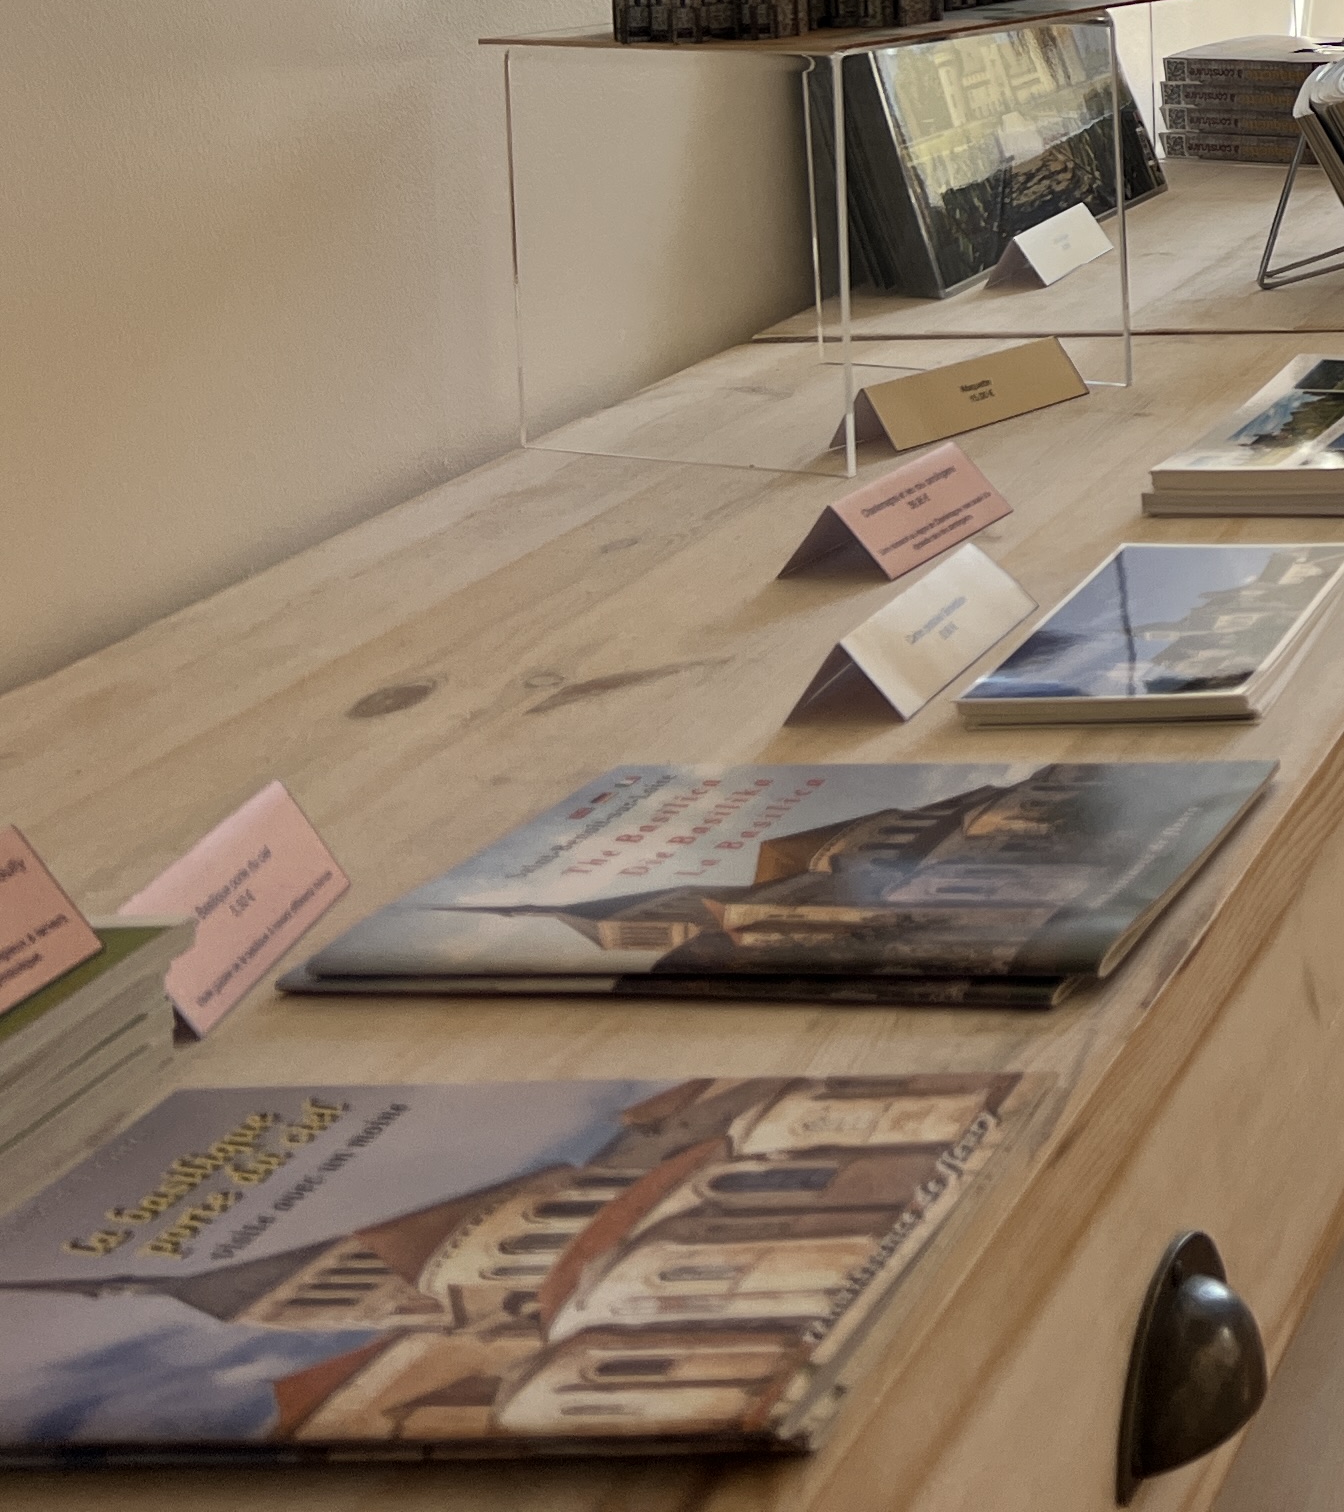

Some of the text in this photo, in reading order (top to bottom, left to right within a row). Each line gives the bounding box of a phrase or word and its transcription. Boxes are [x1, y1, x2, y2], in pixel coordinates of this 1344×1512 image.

[560, 779, 721, 876] The Basilica
[618, 778, 774, 876] Die Basilika
[674, 778, 826, 876] La Basilica
[105, 1111, 283, 1225] basilique
[136, 1096, 351, 1259] porte du ciel
[273, 1173, 325, 1212] avec
[318, 1151, 355, 1172] un
[347, 1102, 410, 1148] moine
